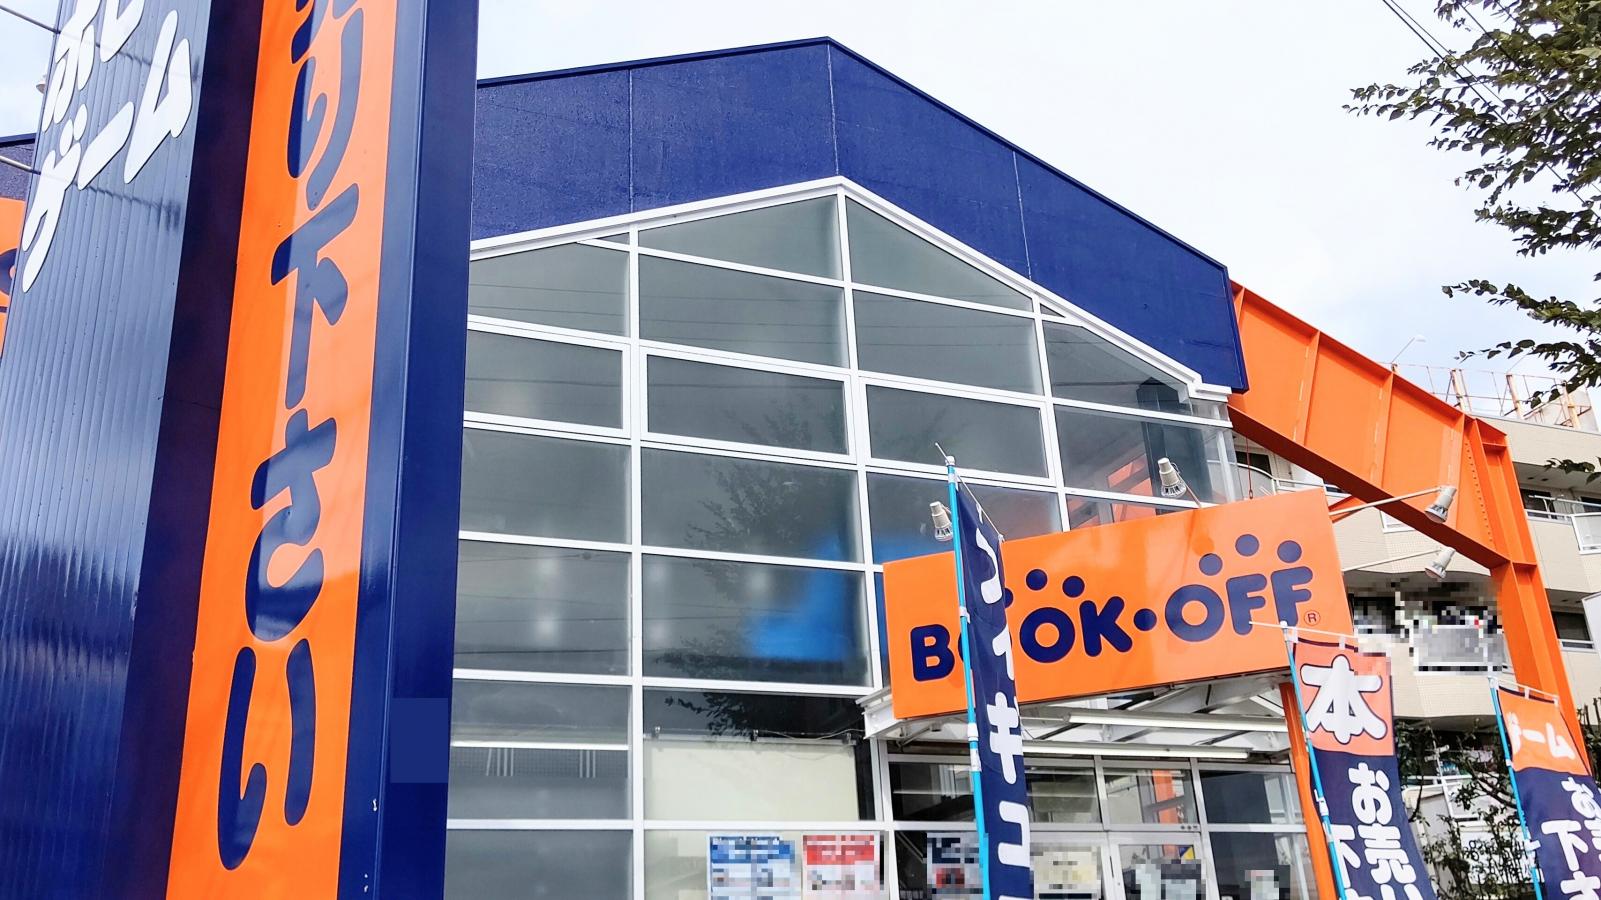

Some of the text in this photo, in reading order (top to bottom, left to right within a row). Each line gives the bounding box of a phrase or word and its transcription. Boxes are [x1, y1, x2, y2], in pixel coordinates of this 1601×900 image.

[22, 9, 193, 293] ゲーム
[1299, 653, 1388, 745] 本
[1348, 762, 1424, 900] お売
